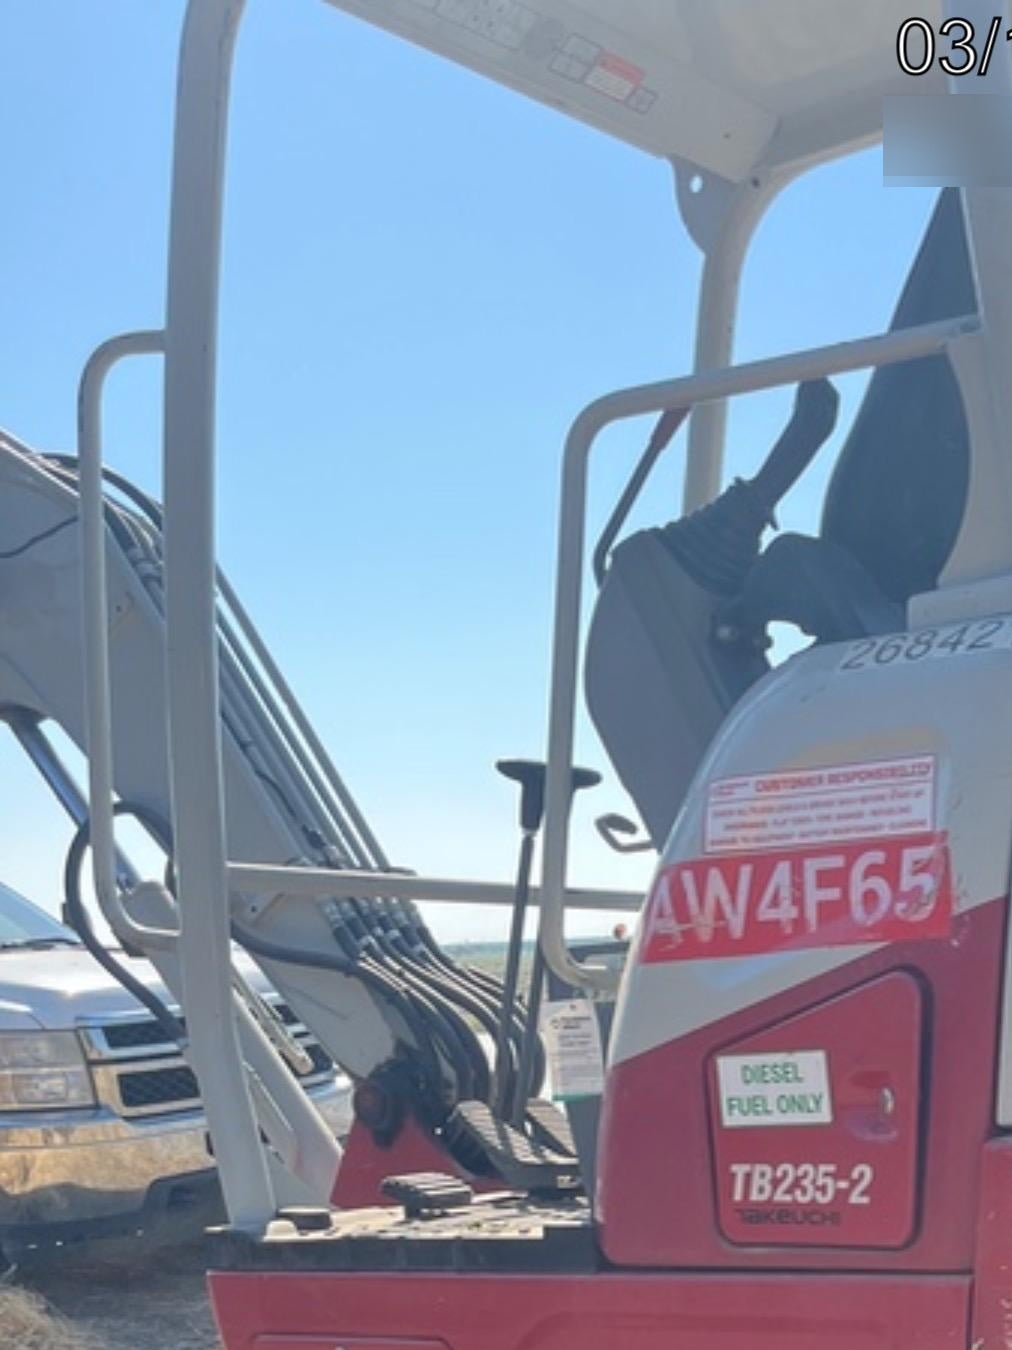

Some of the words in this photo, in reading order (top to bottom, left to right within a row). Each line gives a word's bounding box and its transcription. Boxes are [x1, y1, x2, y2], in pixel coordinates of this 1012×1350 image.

[646, 849, 940, 946] AW4F65
[740, 1062, 804, 1084] DIESEL
[726, 1096, 773, 1116] FUEL
[777, 1094, 823, 1113] ONLY
[730, 1163, 873, 1204] TB235-2
